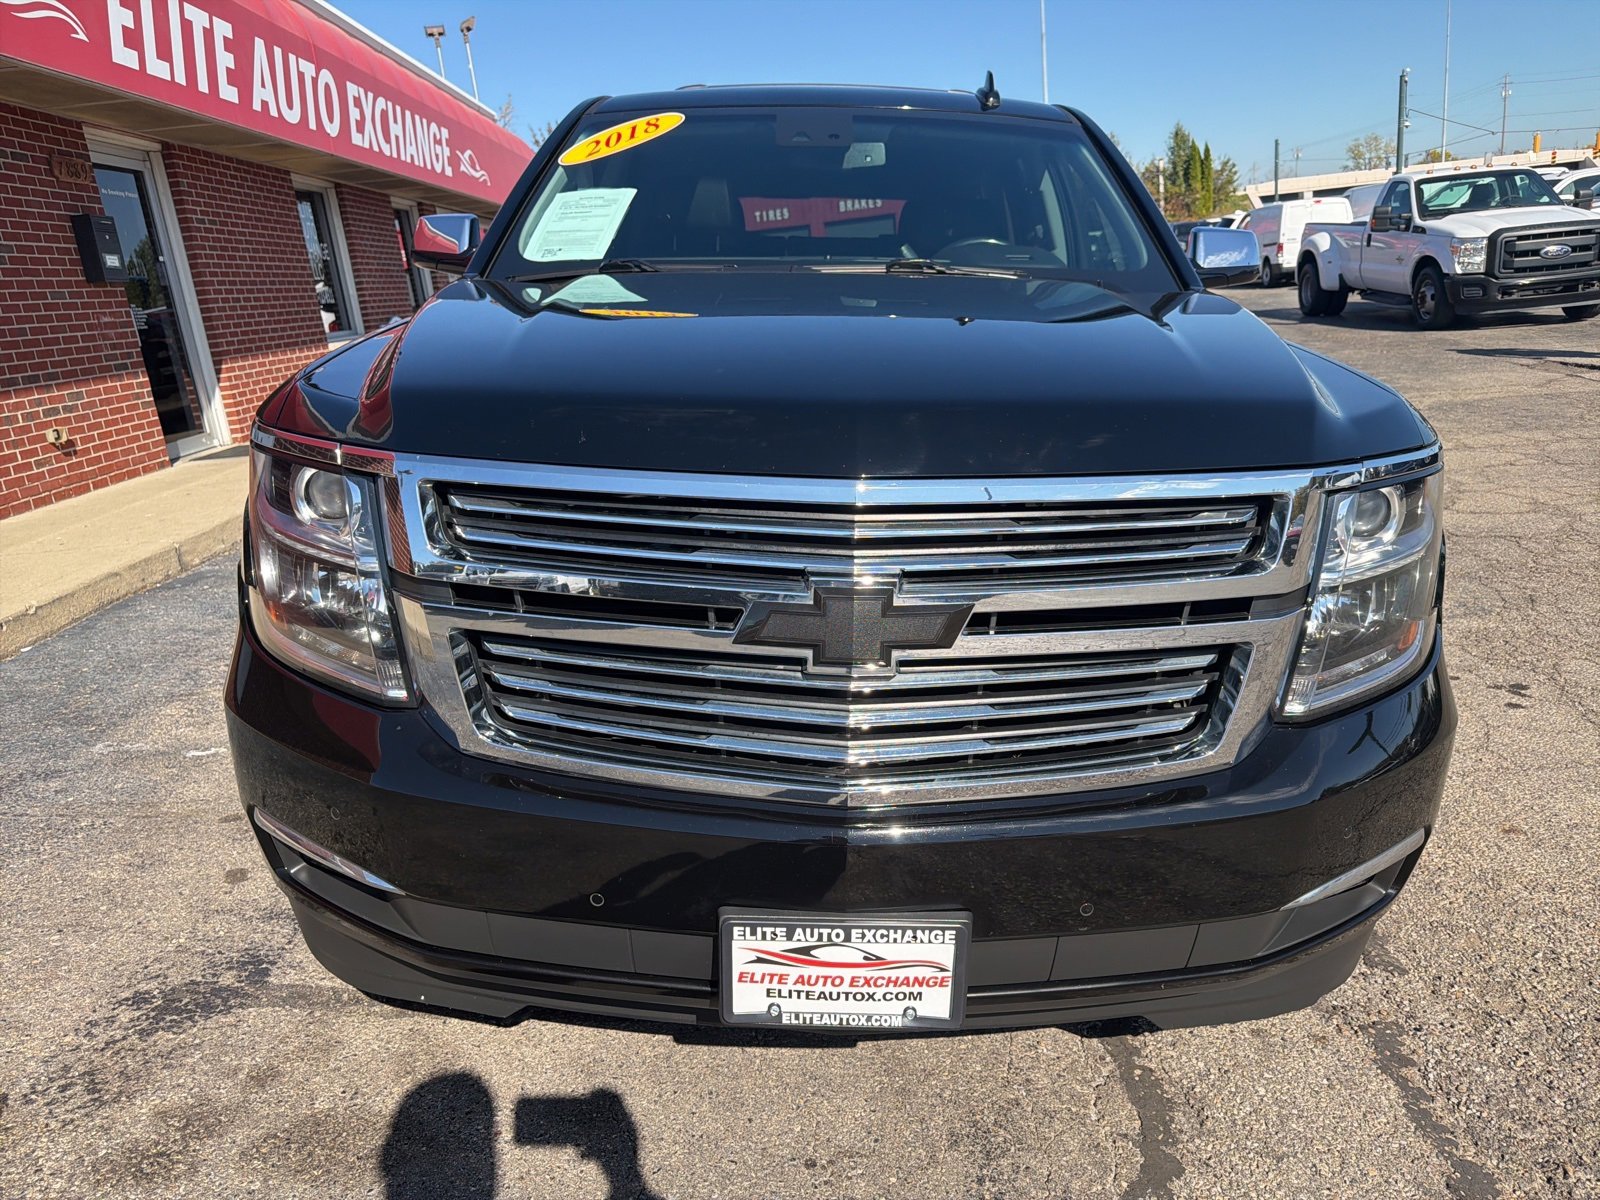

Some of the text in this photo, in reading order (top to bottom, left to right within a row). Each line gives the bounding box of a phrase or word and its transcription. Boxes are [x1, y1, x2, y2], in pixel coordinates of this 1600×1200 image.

[107, 0, 453, 177] ELITE AUTO EXCHANGE
[585, 117, 660, 158] 2018
[754, 199, 882, 222] TIRES BRAKES
[733, 926, 956, 944] ELITE AUTO EXCHANGE
[737, 971, 953, 988] ELITE AUTO EXCHANGE
[765, 988, 923, 1002] ELITEAUTOX.COM
[781, 1012, 902, 1027] ELITEAUTOX.COM
